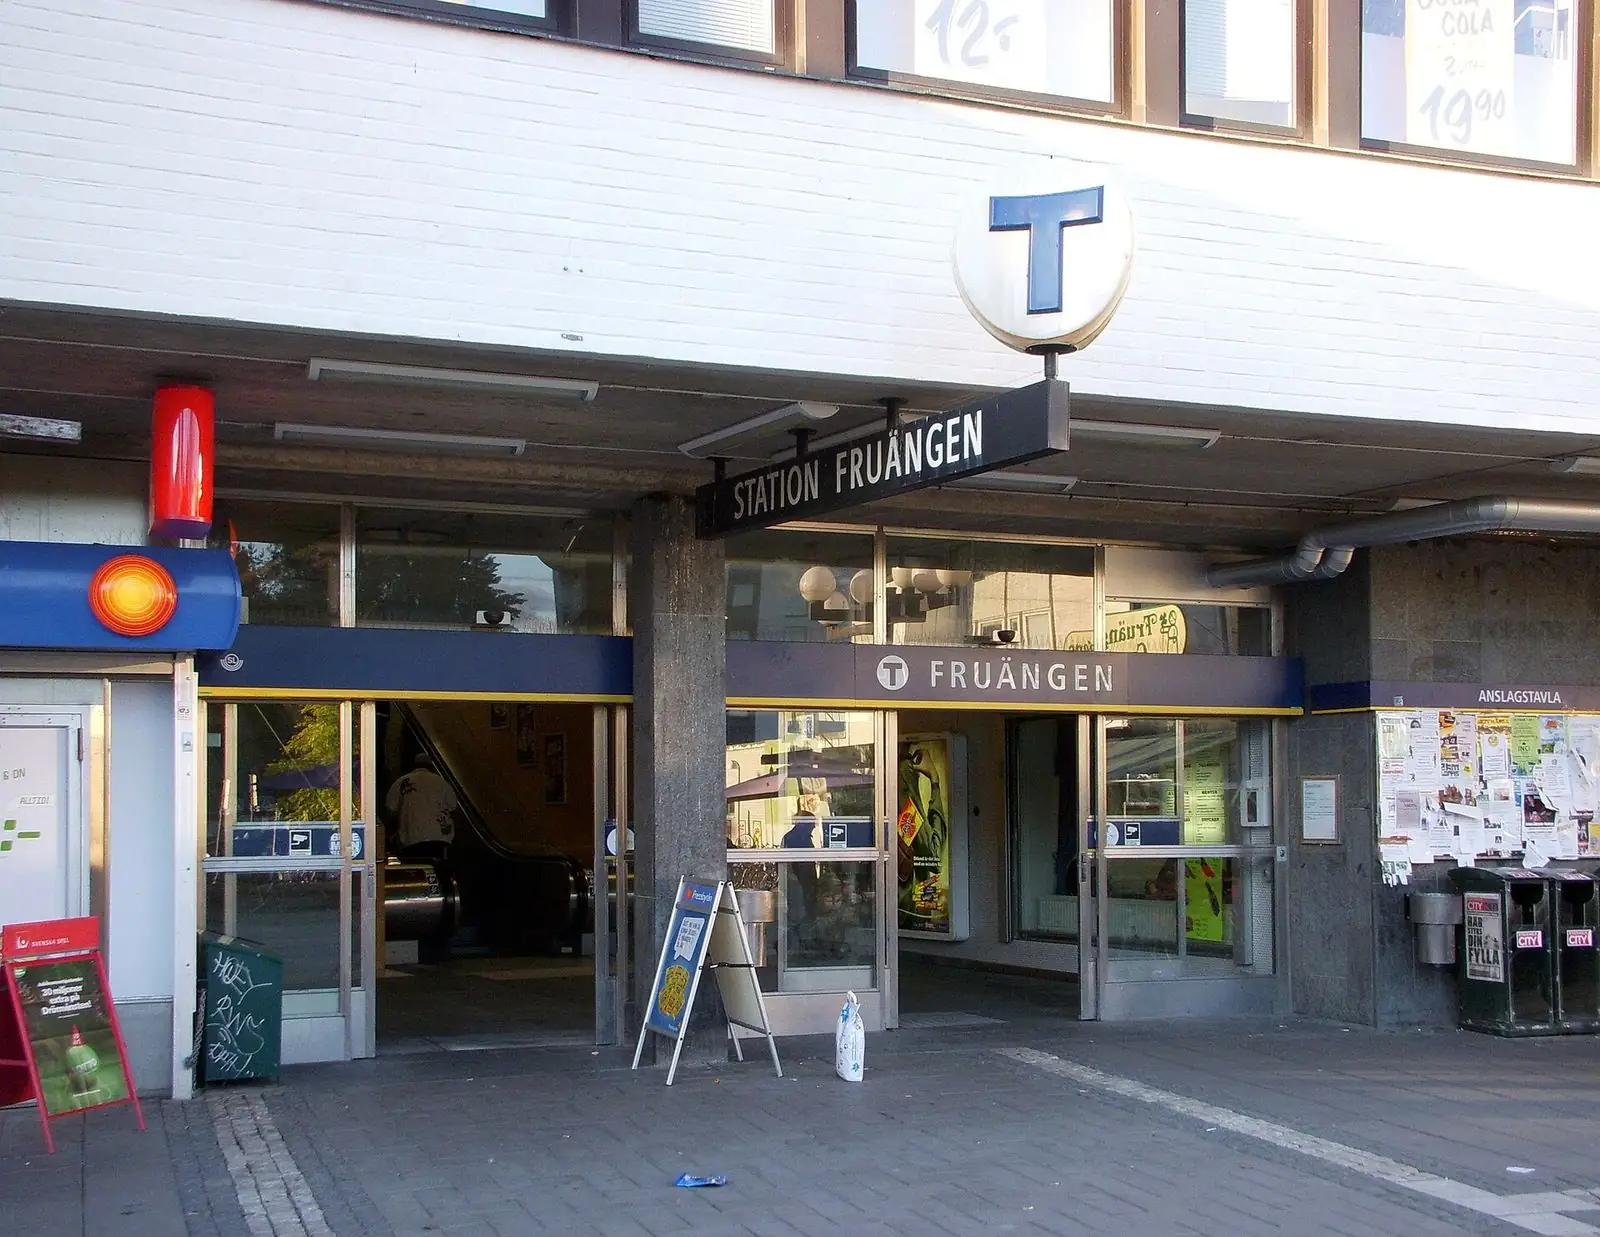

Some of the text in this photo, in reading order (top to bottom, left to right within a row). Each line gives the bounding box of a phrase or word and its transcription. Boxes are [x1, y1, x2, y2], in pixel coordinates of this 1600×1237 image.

[1442, 8, 1494, 37] COLA
[989, 185, 1104, 315] T
[734, 409, 983, 520] STATION FRUÄNGEN
[882, 656, 1113, 692] T FRUÄNGEN
[1478, 689, 1562, 704] ANSLAGSTAVLA
[1467, 901, 1482, 910] CITY
[1467, 935, 1483, 948] DIN
[1518, 936, 1539, 946] CITY
[1568, 935, 1587, 944] CITY
[1468, 947, 1501, 965] FYLLA
